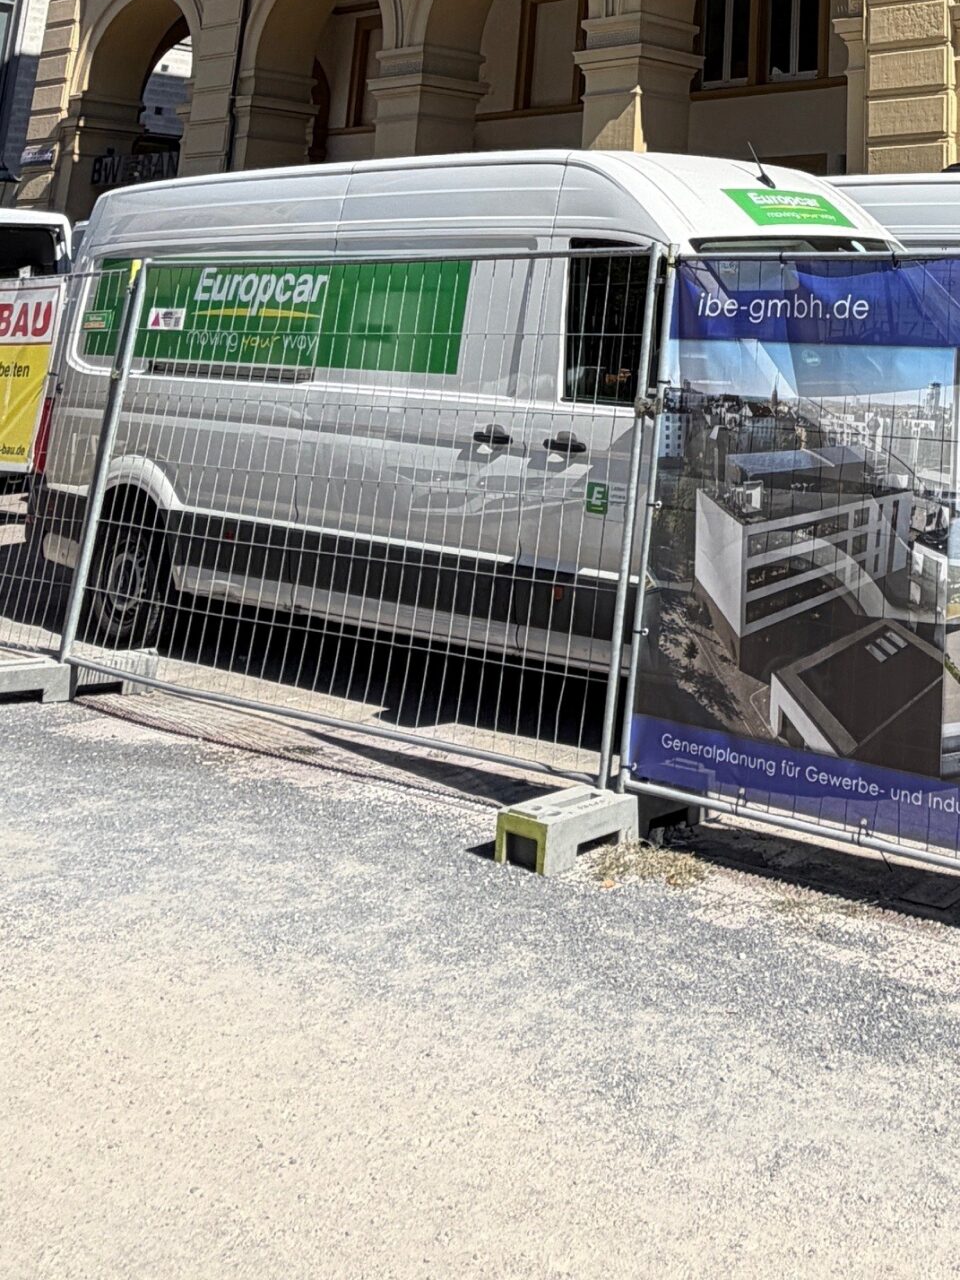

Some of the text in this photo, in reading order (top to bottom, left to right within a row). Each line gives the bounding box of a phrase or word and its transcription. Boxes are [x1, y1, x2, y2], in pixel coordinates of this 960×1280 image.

[91, 156, 121, 184] BW
[746, 192, 820, 207] Europcar
[193, 267, 328, 316] Europcar
[698, 293, 869, 323] ibe-gmbh.de
[186, 330, 318, 356] moving your way
[661, 733, 776, 776] Generalplanung
[781, 760, 800, 779] für
[805, 765, 885, 797] Gewerbe-
[891, 787, 922, 806] und
